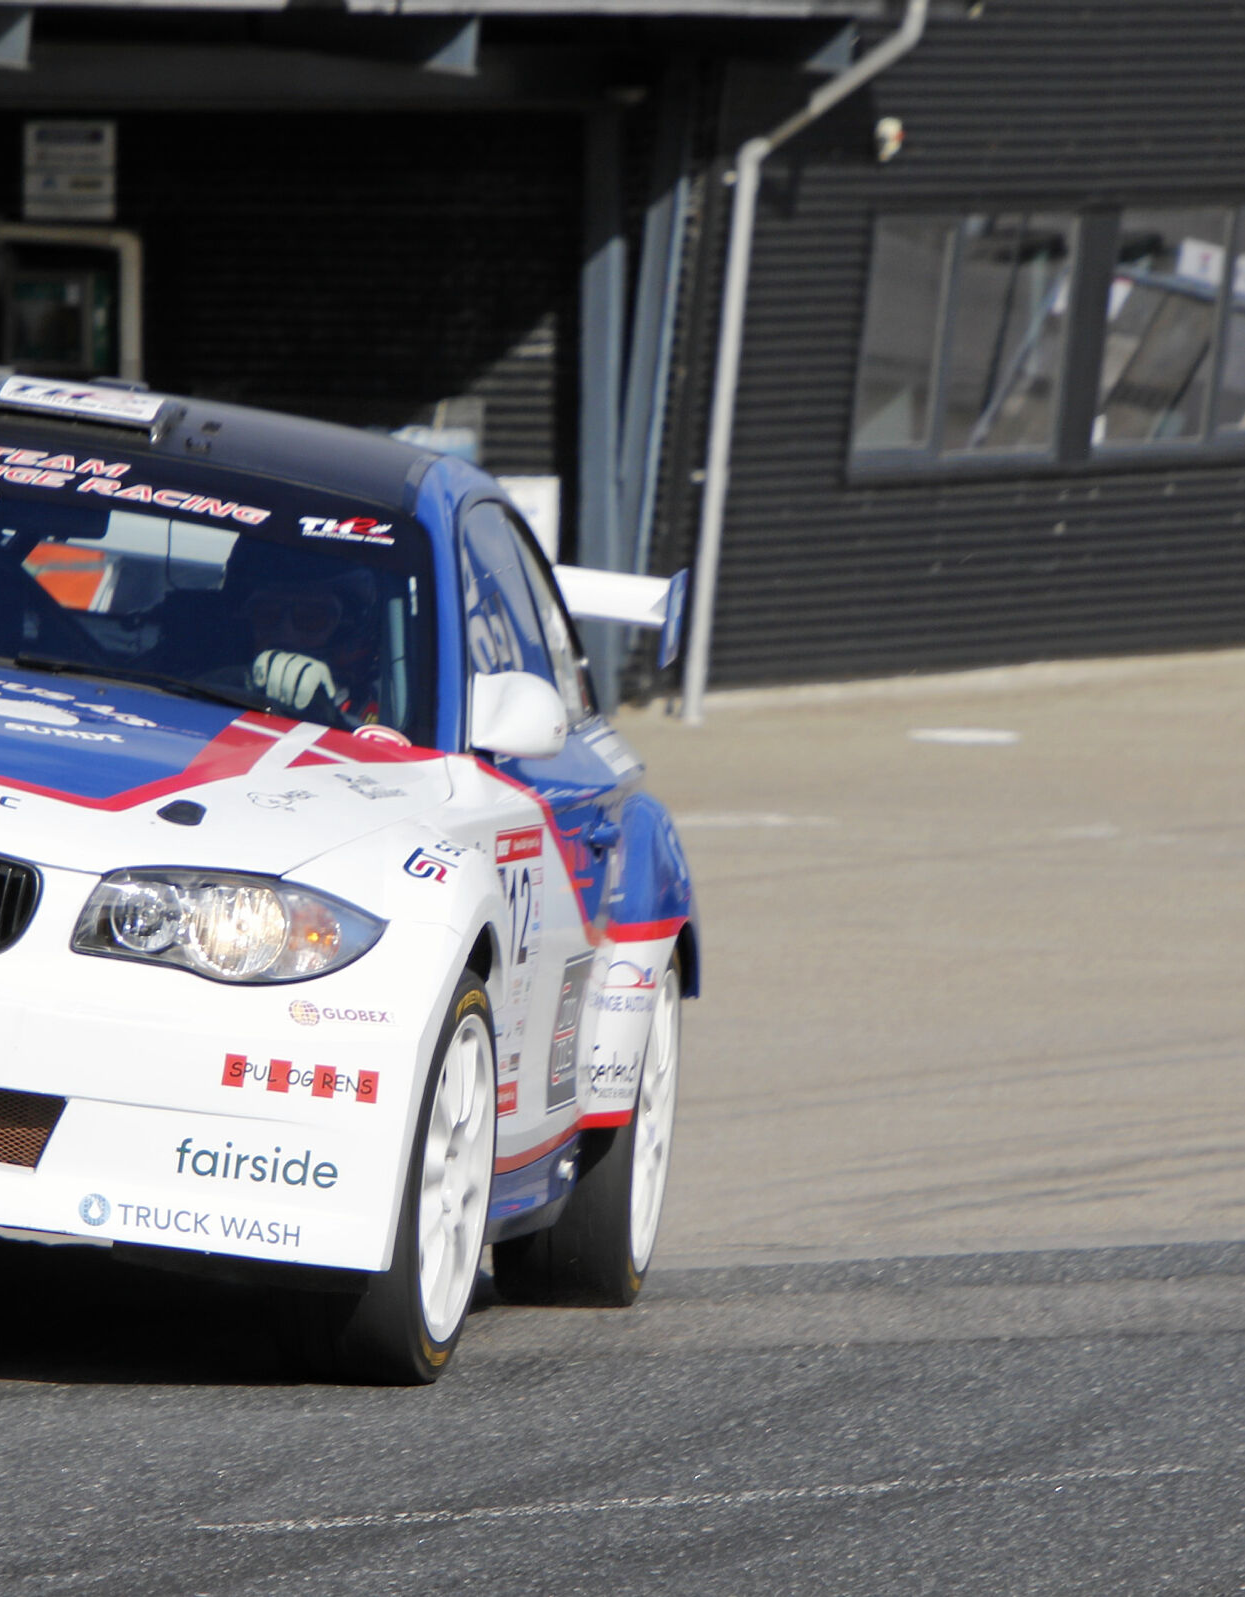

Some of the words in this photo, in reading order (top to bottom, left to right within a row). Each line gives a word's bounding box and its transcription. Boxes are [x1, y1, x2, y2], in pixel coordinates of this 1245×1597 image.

[77, 475, 272, 525] RACING
[322, 1006, 391, 1024] GLOBEX
[229, 1061, 278, 1083] SPUL
[286, 1069, 314, 1088] OG
[321, 1072, 373, 1095] RENS
[175, 1137, 339, 1190] fairside
[117, 1203, 211, 1236] TRUCK
[219, 1214, 302, 1248] WASH
